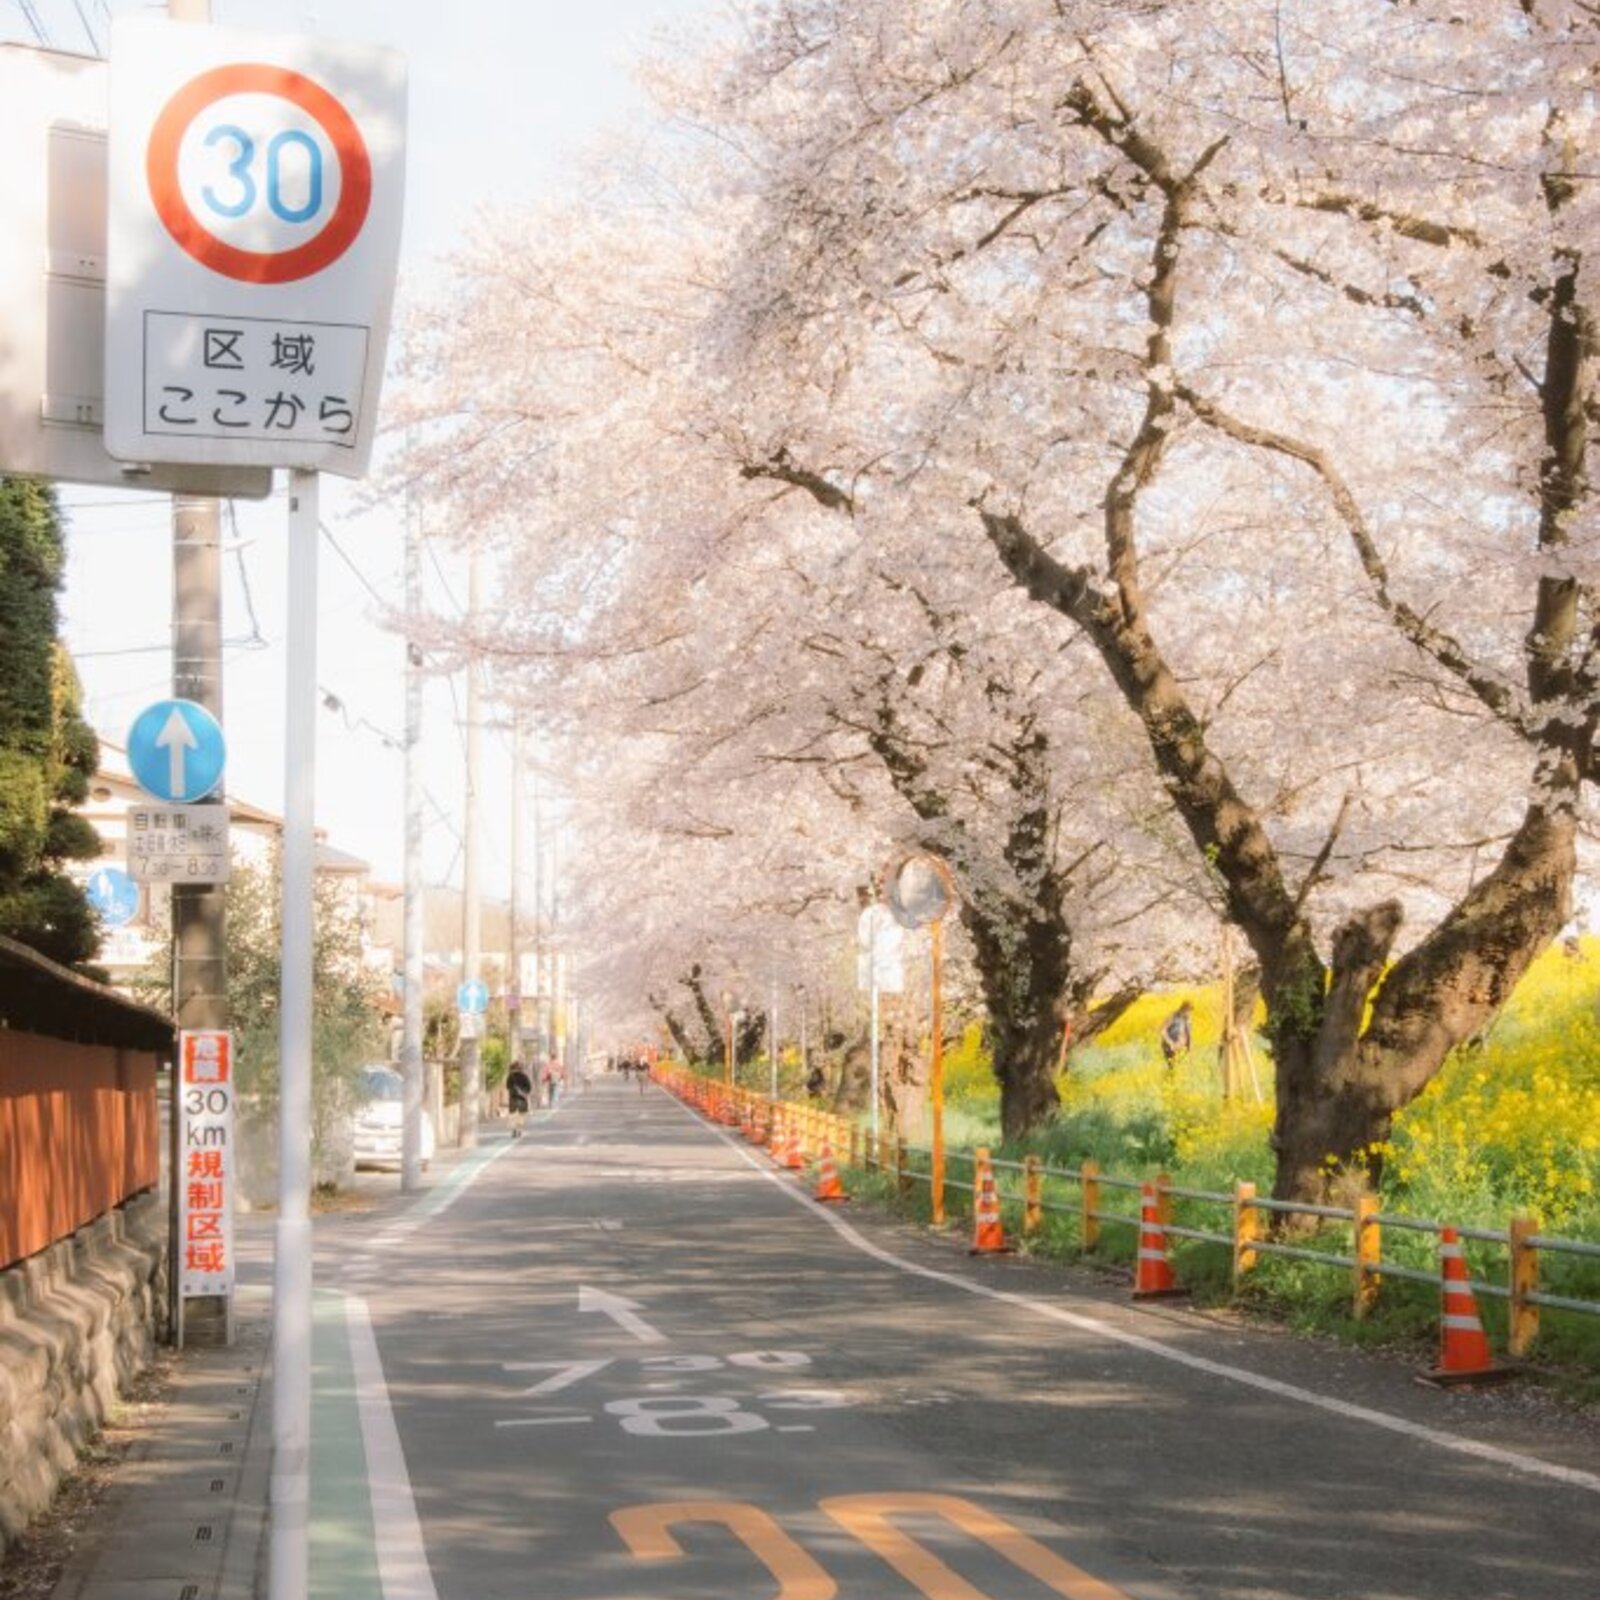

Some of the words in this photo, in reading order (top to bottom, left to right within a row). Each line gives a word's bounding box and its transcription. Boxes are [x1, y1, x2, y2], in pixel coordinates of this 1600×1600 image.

[202, 124, 322, 223] 30
[204, 329, 315, 375] 区域
[159, 386, 354, 434] ここから
[186, 1089, 228, 1115] 30
[186, 1121, 226, 1146] km
[186, 1151, 225, 1272] 規制区域
